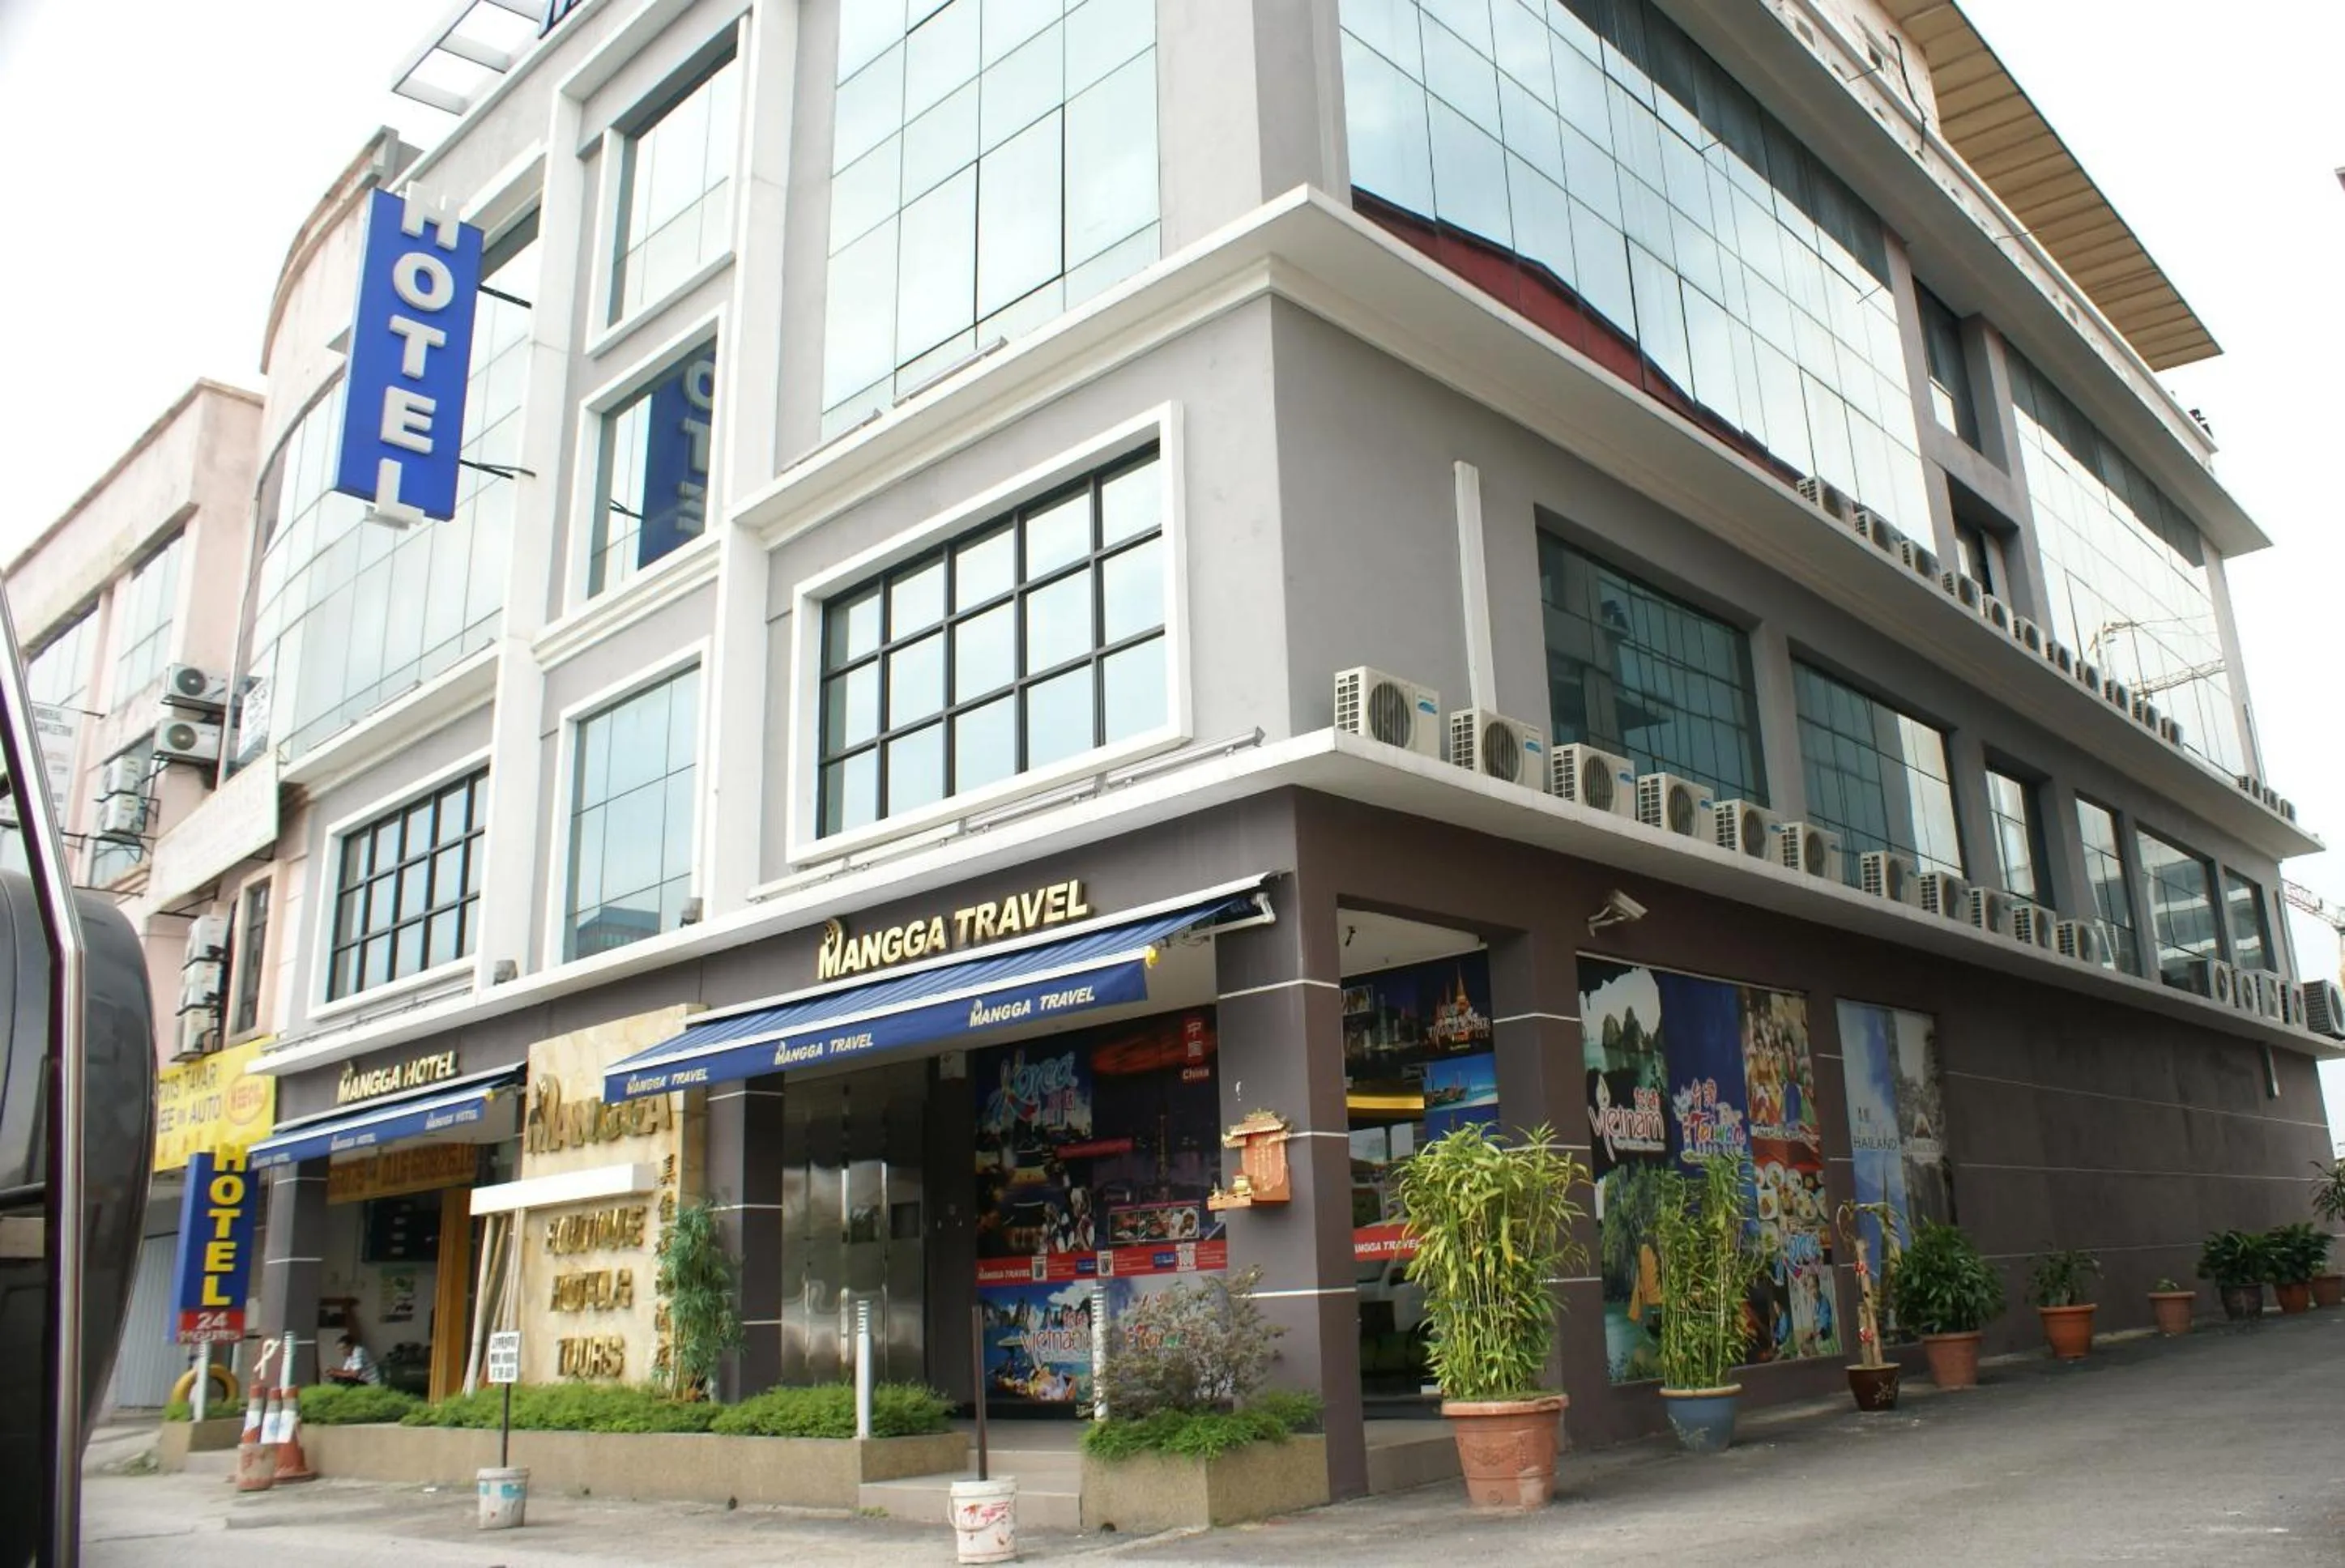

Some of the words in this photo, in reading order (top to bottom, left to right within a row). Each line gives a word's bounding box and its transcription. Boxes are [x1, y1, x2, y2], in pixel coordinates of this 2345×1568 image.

[373, 179, 460, 526] HOTEL
[817, 916, 947, 980] MANGGA
[954, 880, 1089, 944] TRAVEL
[970, 999, 1031, 1027] MANGGA
[1039, 986, 1095, 1011] TRAVEL
[775, 1042, 823, 1066] MANGGA
[829, 1033, 874, 1054] TRAVEL
[337, 1063, 401, 1103] MANGGA
[404, 1050, 456, 1086] HOTEL
[626, 1075, 666, 1095] MANGGA
[671, 1067, 709, 1086] TRAVEL
[190, 1095, 222, 1126] AUTO
[201, 1140, 249, 1306] HOTEL
[198, 1312, 228, 1330] 24
[556, 1336, 625, 1378] TOURS
